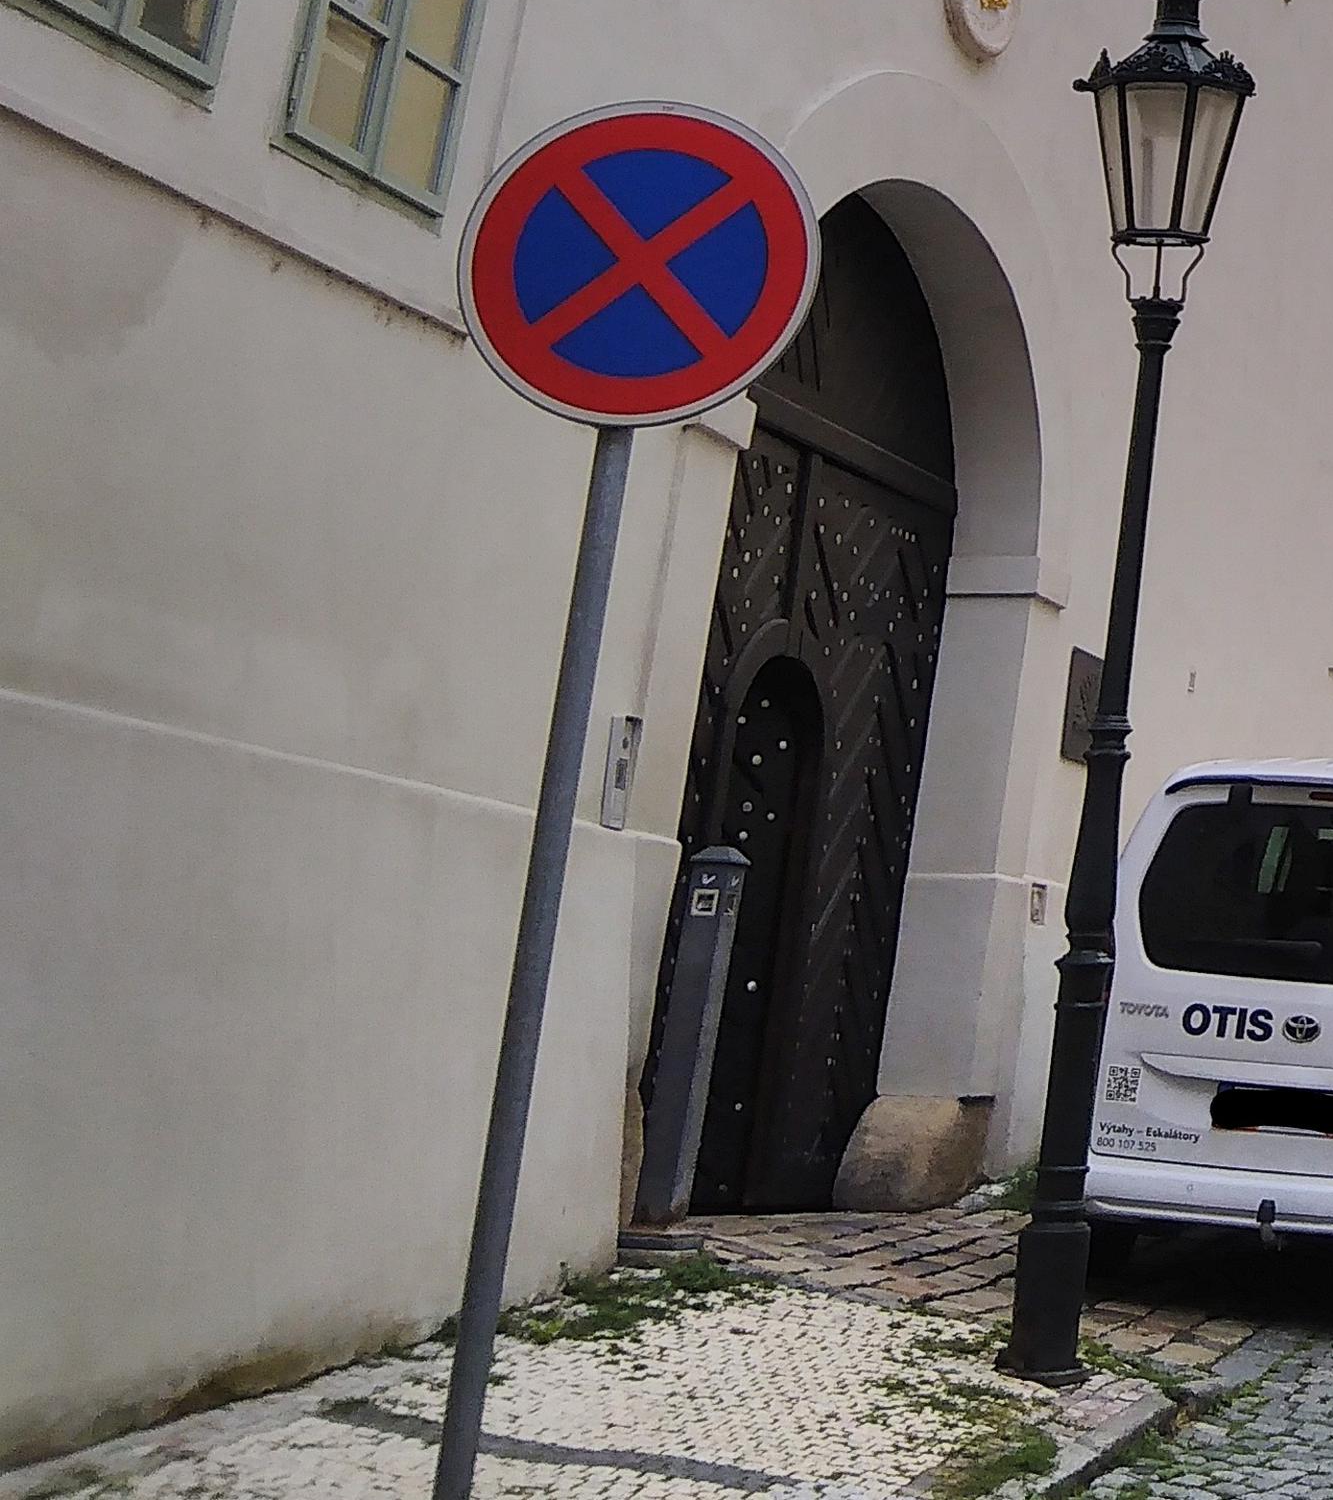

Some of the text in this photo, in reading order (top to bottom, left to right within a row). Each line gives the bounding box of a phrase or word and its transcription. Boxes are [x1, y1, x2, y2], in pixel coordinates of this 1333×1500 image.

[1119, 1002, 1169, 1018] TOYOTA
[1182, 1003, 1273, 1042] OTIS
[1099, 1122, 1135, 1137] Výtahy
[1146, 1127, 1201, 1144] Eskalátory
[1097, 1137, 1156, 1152] 800 107 525
